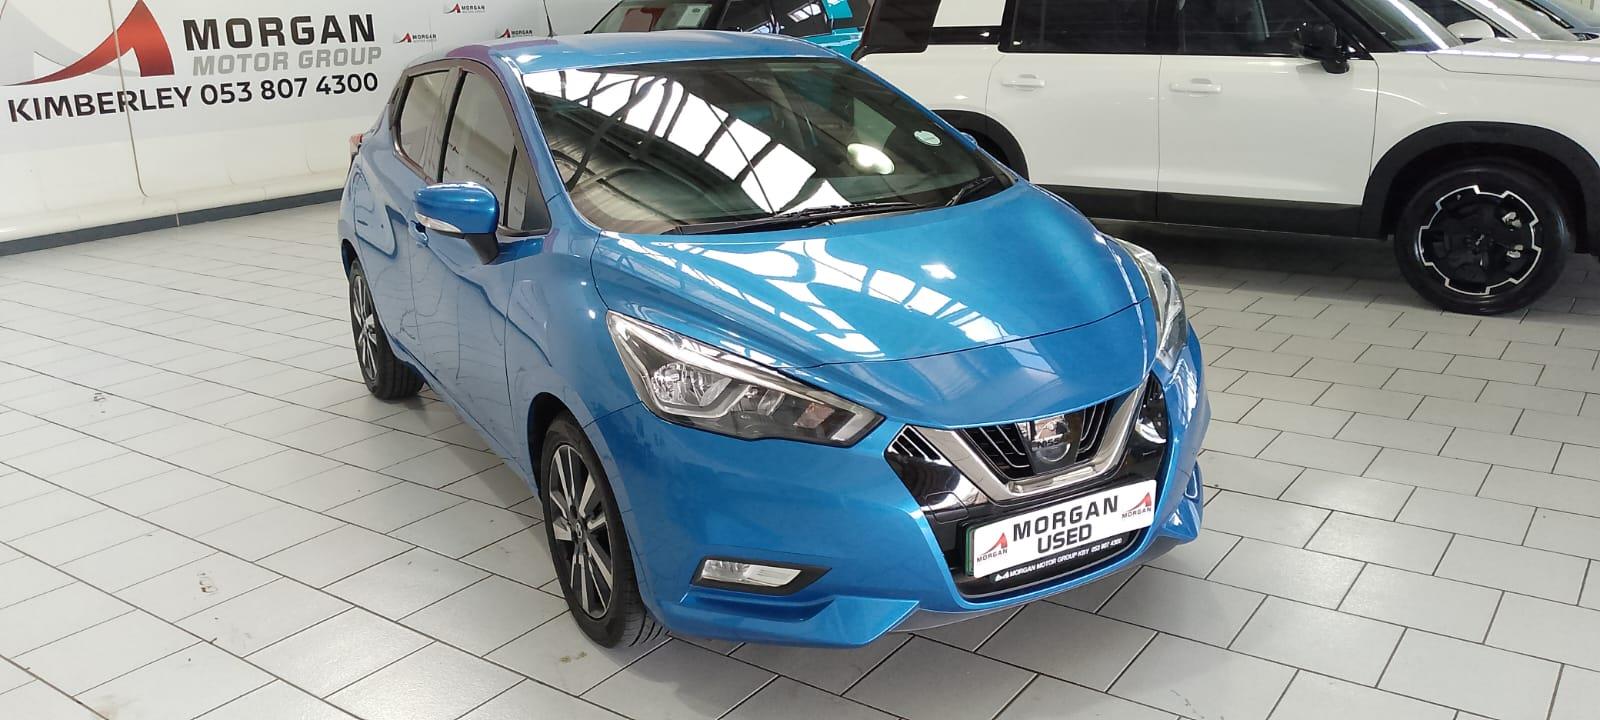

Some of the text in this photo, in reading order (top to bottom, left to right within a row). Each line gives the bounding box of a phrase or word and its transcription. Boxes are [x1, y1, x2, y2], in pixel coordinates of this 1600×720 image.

[183, 14, 375, 51] MORGAN
[193, 46, 382, 76] MOTOR GROUP
[8, 72, 378, 122] KIMBERLEY 053 807 4300
[1013, 495, 1118, 541] MORGAN
[1121, 507, 1152, 520] MORGAN
[1037, 524, 1092, 554] USED
[976, 549, 1008, 564] MORGAN
[1009, 565, 1036, 577] MORGAN
[1037, 558, 1057, 569] MOTOR
[1057, 551, 1078, 563] GROUP
